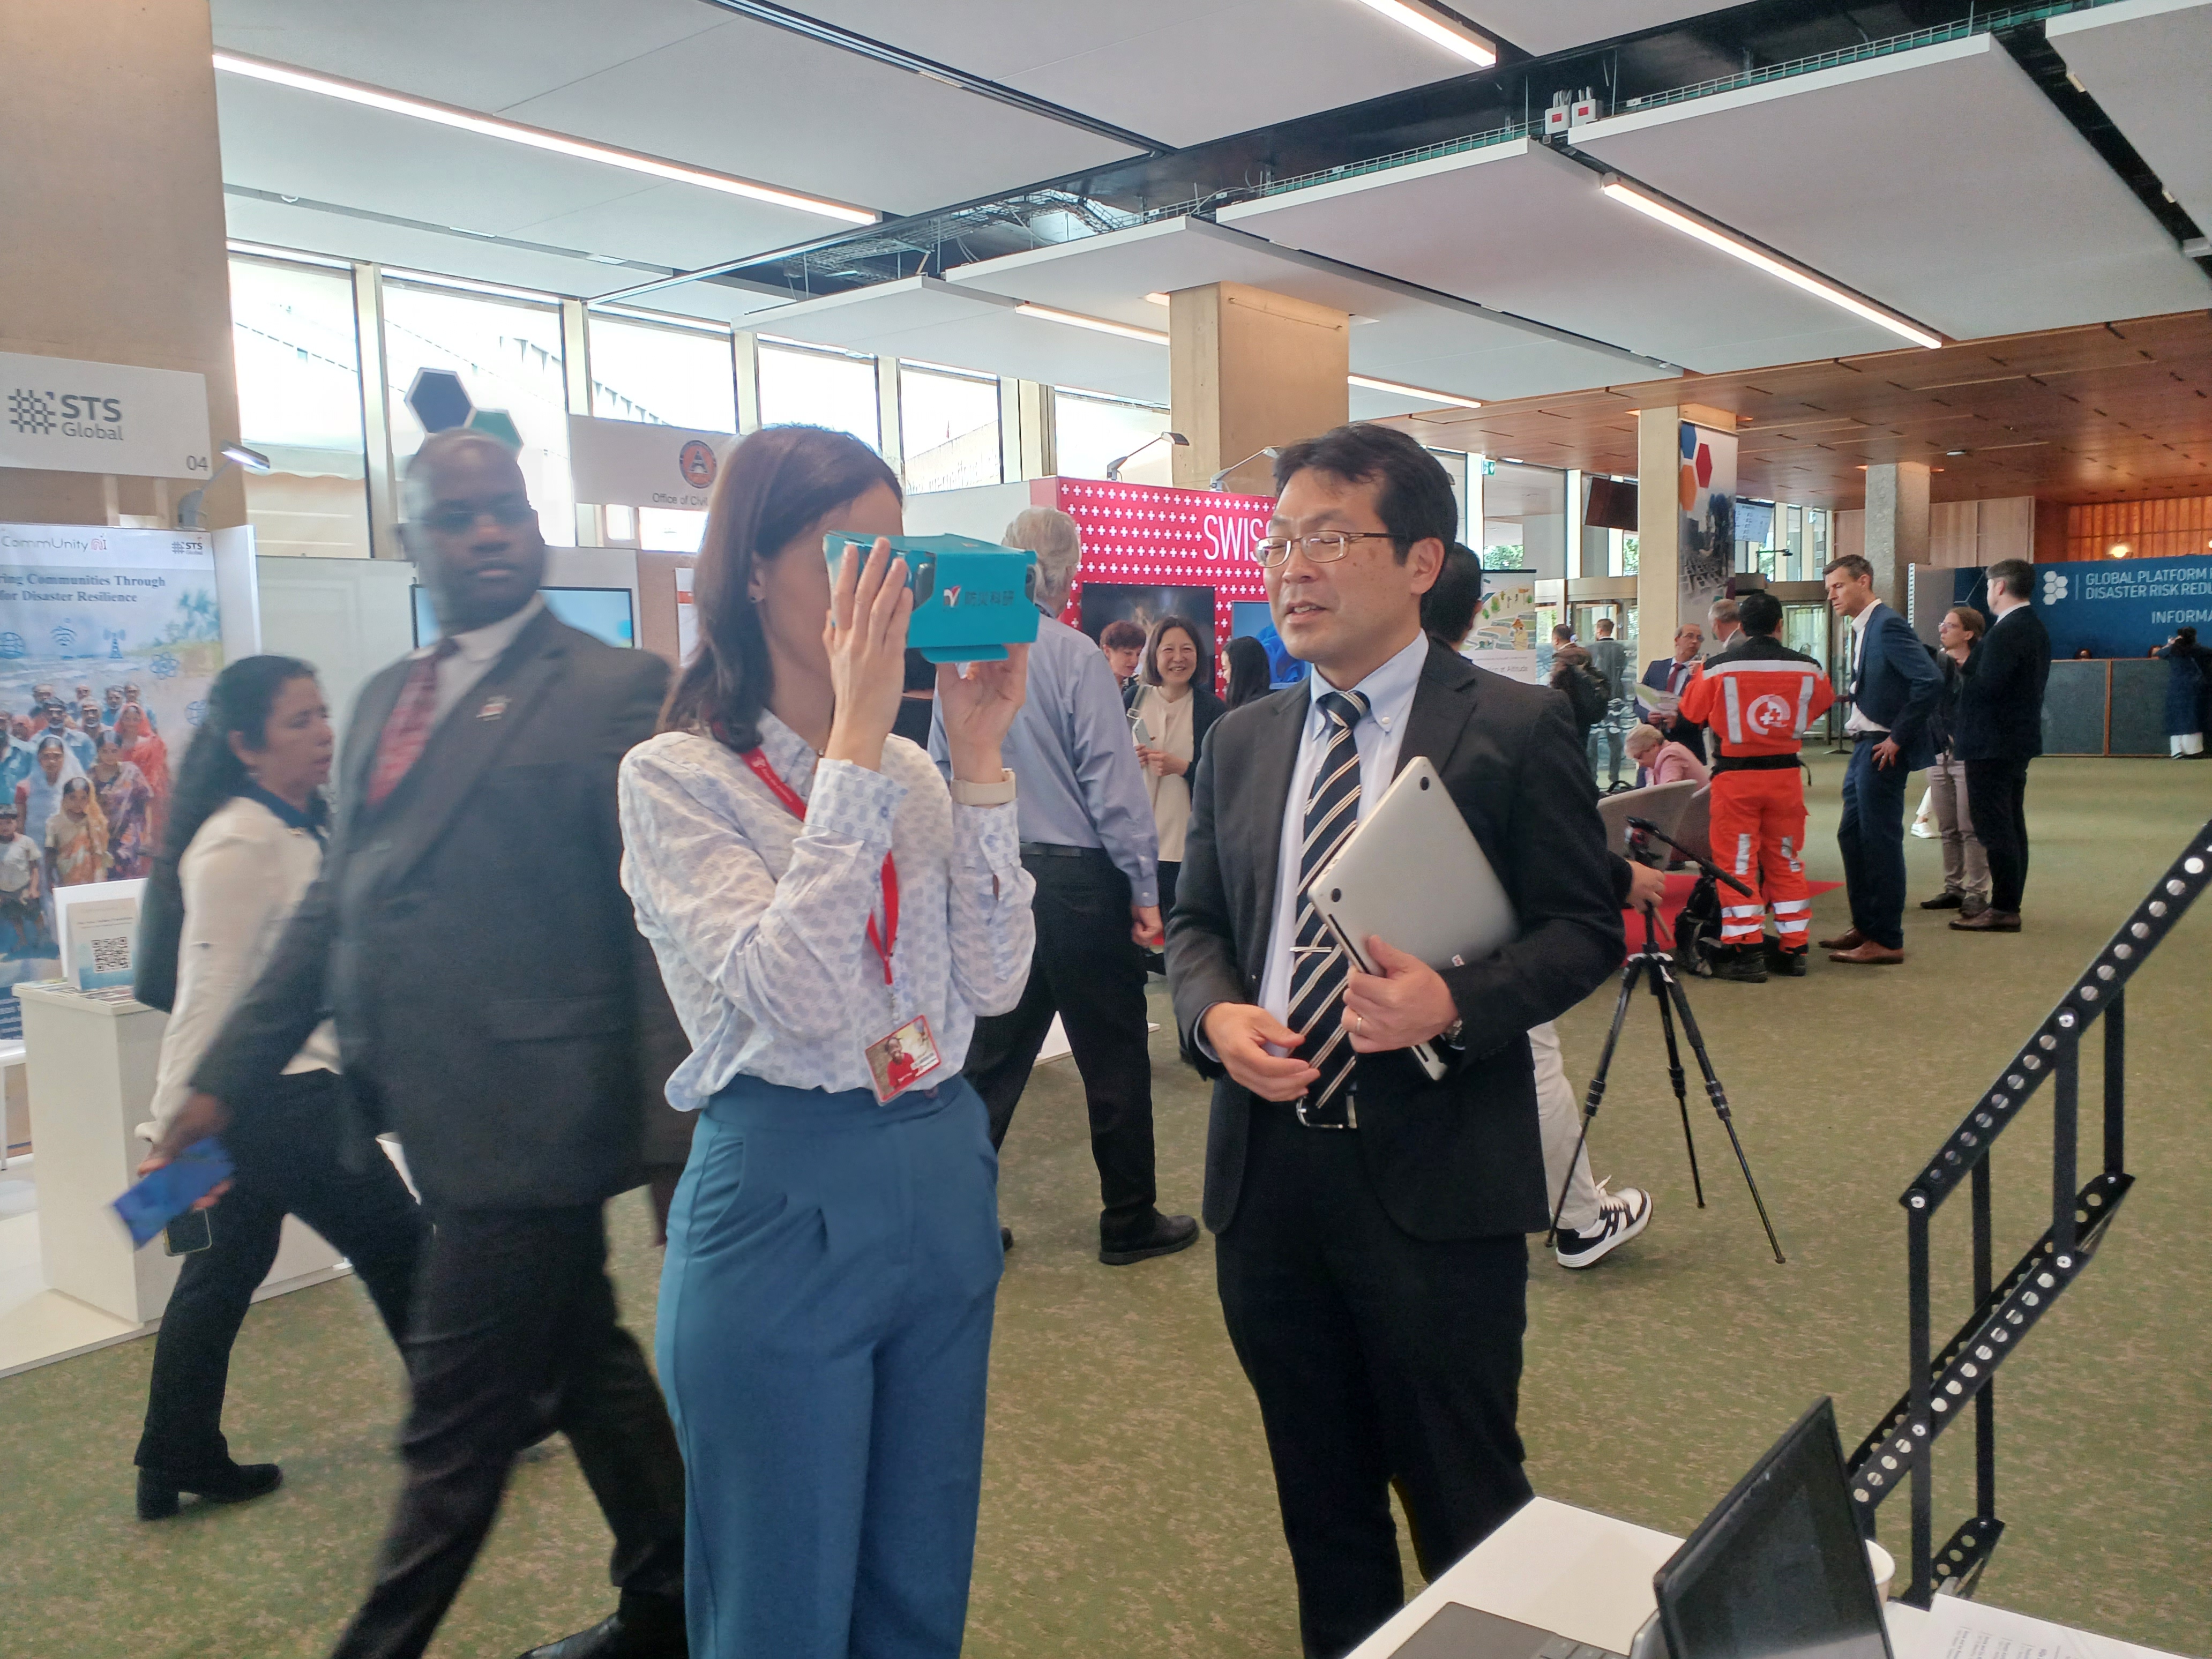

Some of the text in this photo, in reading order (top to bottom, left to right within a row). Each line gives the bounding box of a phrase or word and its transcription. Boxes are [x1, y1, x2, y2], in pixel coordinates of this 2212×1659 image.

[61, 394, 122, 422] STS
[61, 421, 124, 441] Global
[186, 455, 209, 472] 04
[652, 492, 677, 504] Office
[1, 536, 88, 552] CommUnity
[27, 573, 110, 585] Communities
[114, 576, 166, 588] Through
[2085, 571, 2136, 586] GLOBAL
[2137, 567, 2207, 583] PLATFORM
[23, 591, 73, 601] Disaster
[77, 591, 137, 602] Resilience
[2085, 585, 2147, 600] DISASTER
[2149, 583, 2179, 597] RISK
